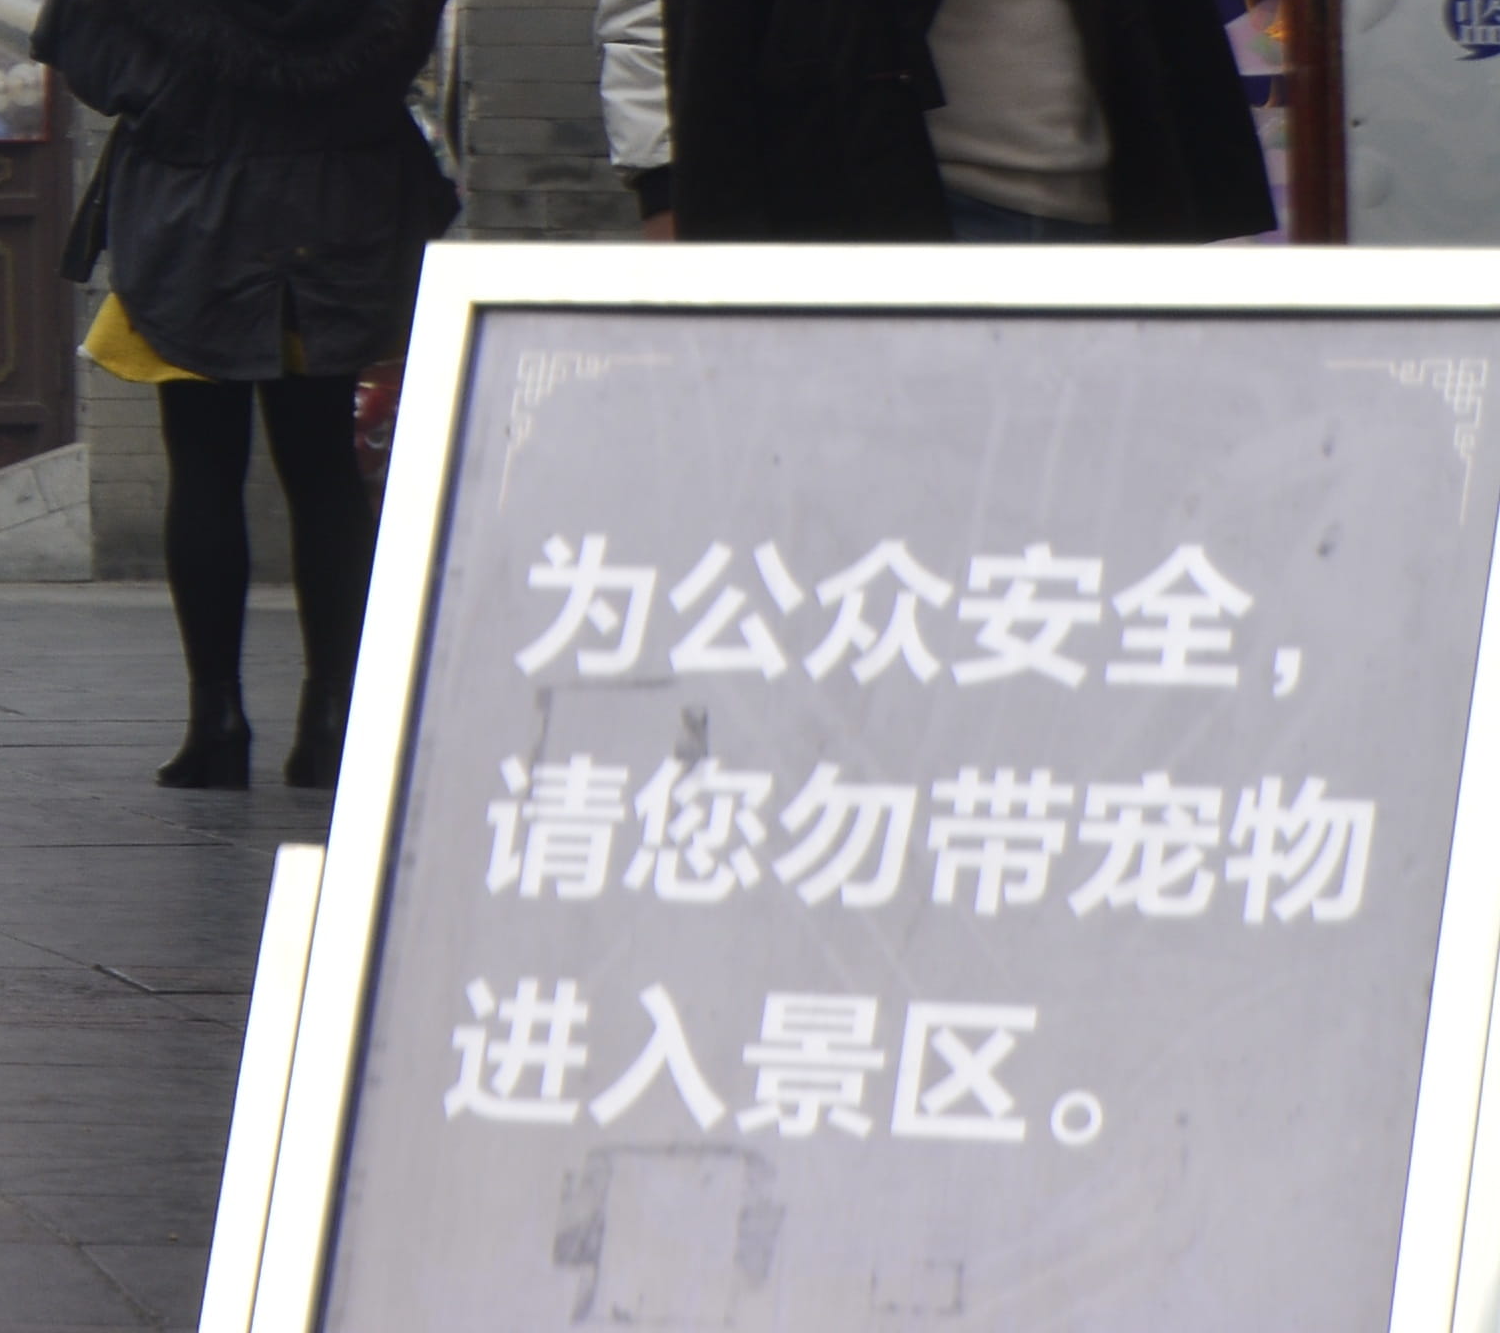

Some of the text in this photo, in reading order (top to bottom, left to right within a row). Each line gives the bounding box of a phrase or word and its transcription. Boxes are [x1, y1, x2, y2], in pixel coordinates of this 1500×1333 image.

[514, 533, 1304, 699] 为公众安全，
[483, 753, 1377, 926] 请您勿带宠物
[443, 977, 1103, 1146] 进入景区。
